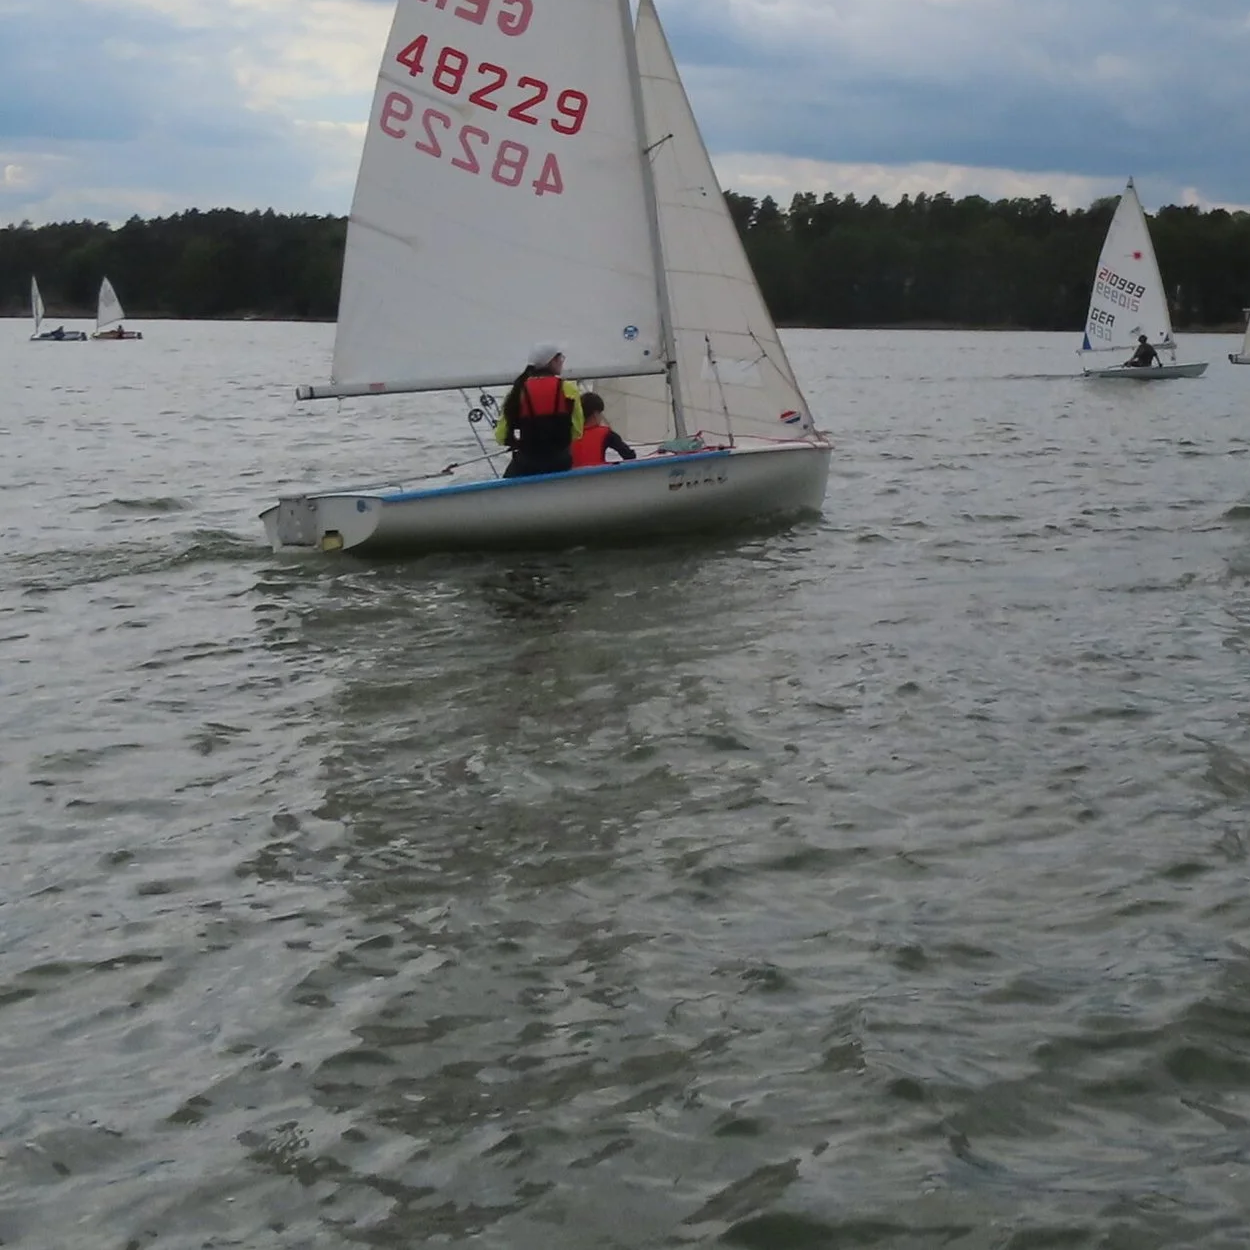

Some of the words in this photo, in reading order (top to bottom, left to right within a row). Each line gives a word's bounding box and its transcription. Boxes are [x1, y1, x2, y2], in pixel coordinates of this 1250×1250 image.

[396, 34, 588, 135] 48229
[1098, 267, 1146, 298] 210999
[1091, 307, 1115, 328] GER
